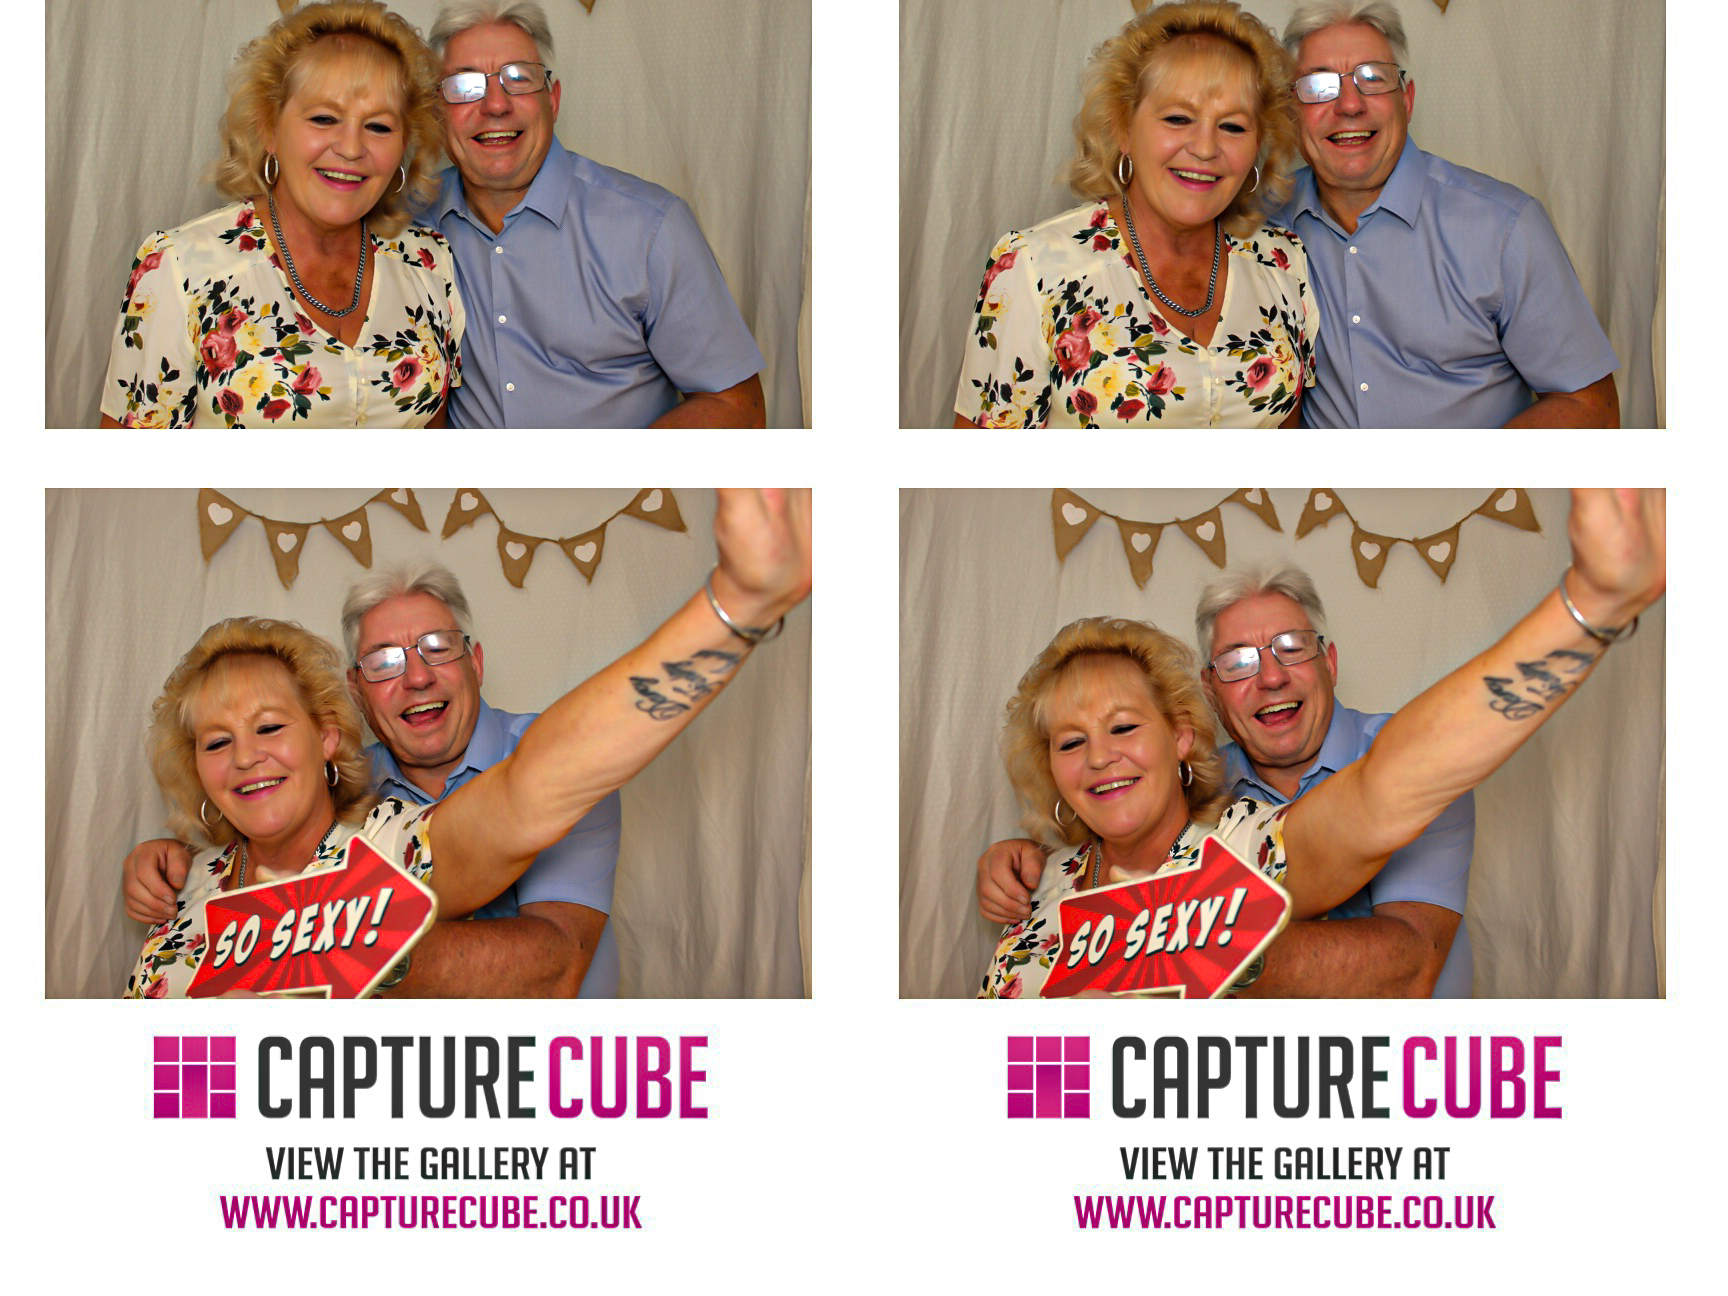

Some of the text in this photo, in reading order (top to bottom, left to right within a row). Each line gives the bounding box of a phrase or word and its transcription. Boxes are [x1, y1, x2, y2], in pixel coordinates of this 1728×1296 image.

[213, 887, 394, 969] SO SEXY!
[1067, 887, 1248, 969] SO SEXY!
